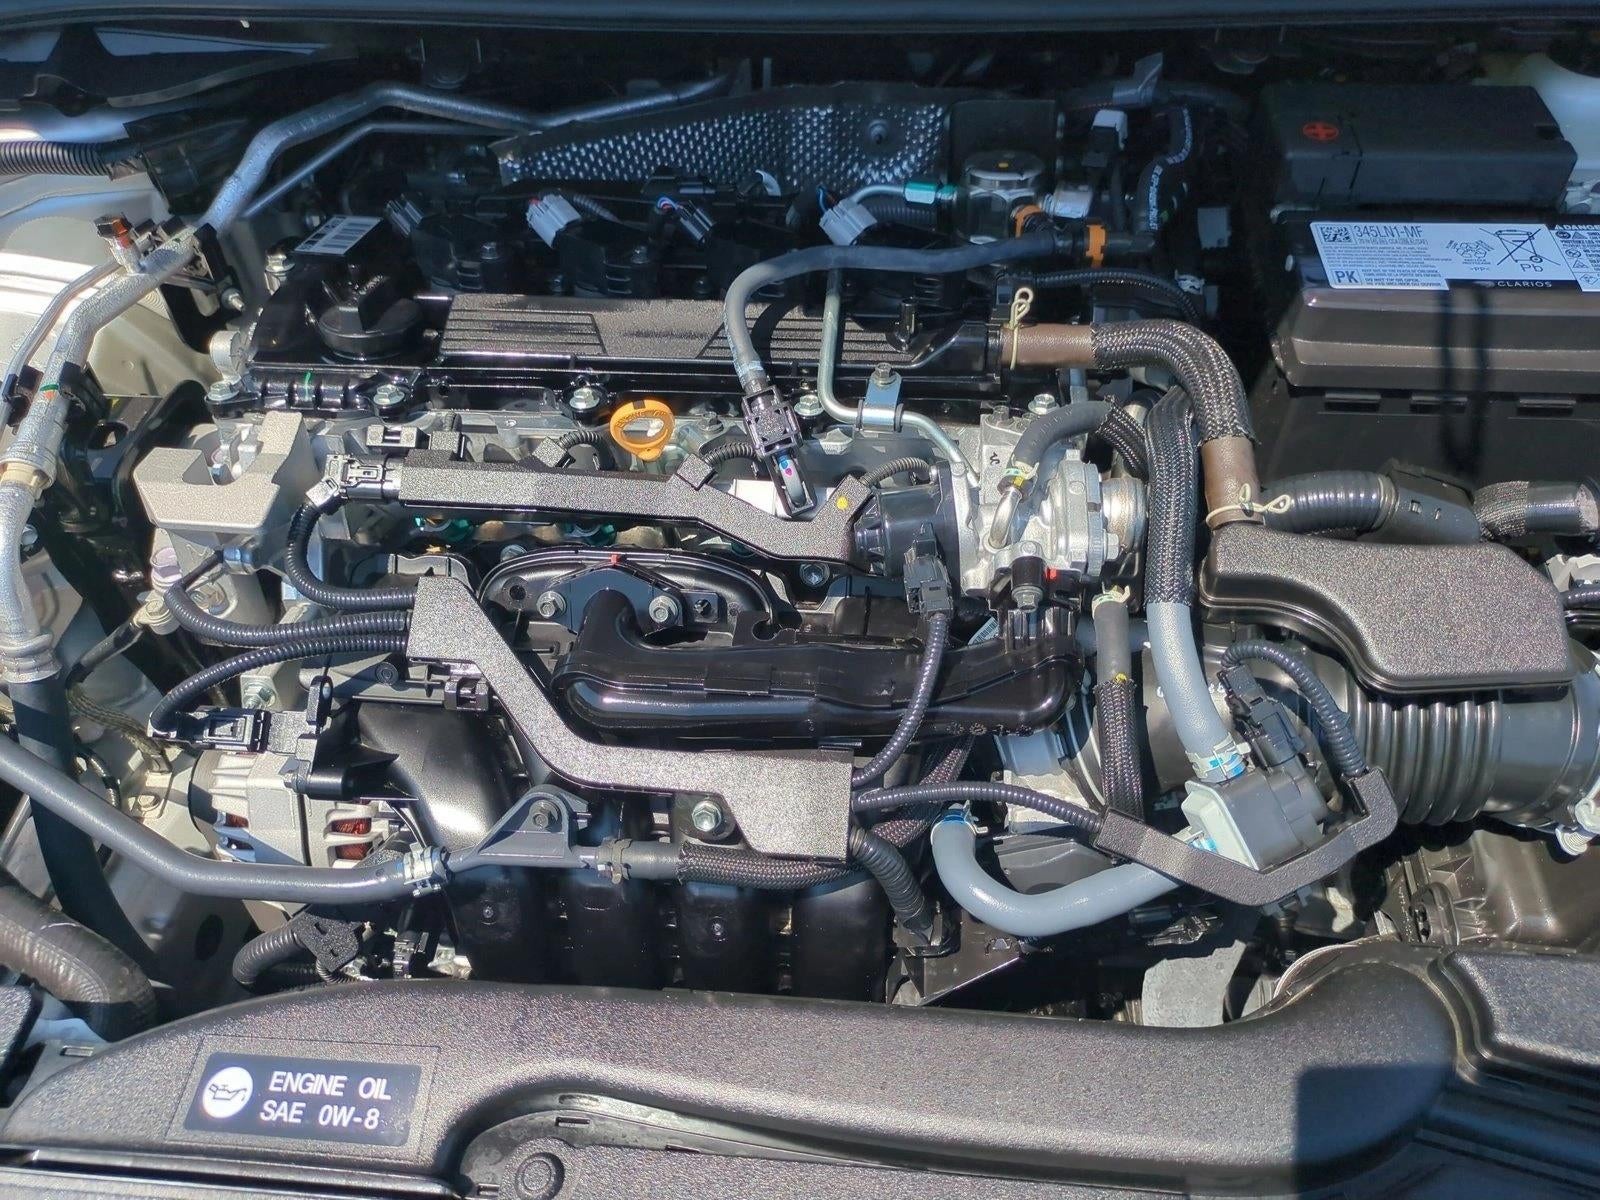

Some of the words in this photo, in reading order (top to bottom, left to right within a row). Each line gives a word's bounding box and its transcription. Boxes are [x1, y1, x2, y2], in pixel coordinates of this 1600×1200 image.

[1353, 225, 1423, 238] 345LN1-MF
[1520, 263, 1543, 273] Pb
[1334, 270, 1359, 284] PK
[269, 1071, 347, 1096] ENGINE
[358, 1076, 392, 1100] OIL
[260, 1099, 306, 1123] SAE
[318, 1105, 380, 1130] 0W-8
